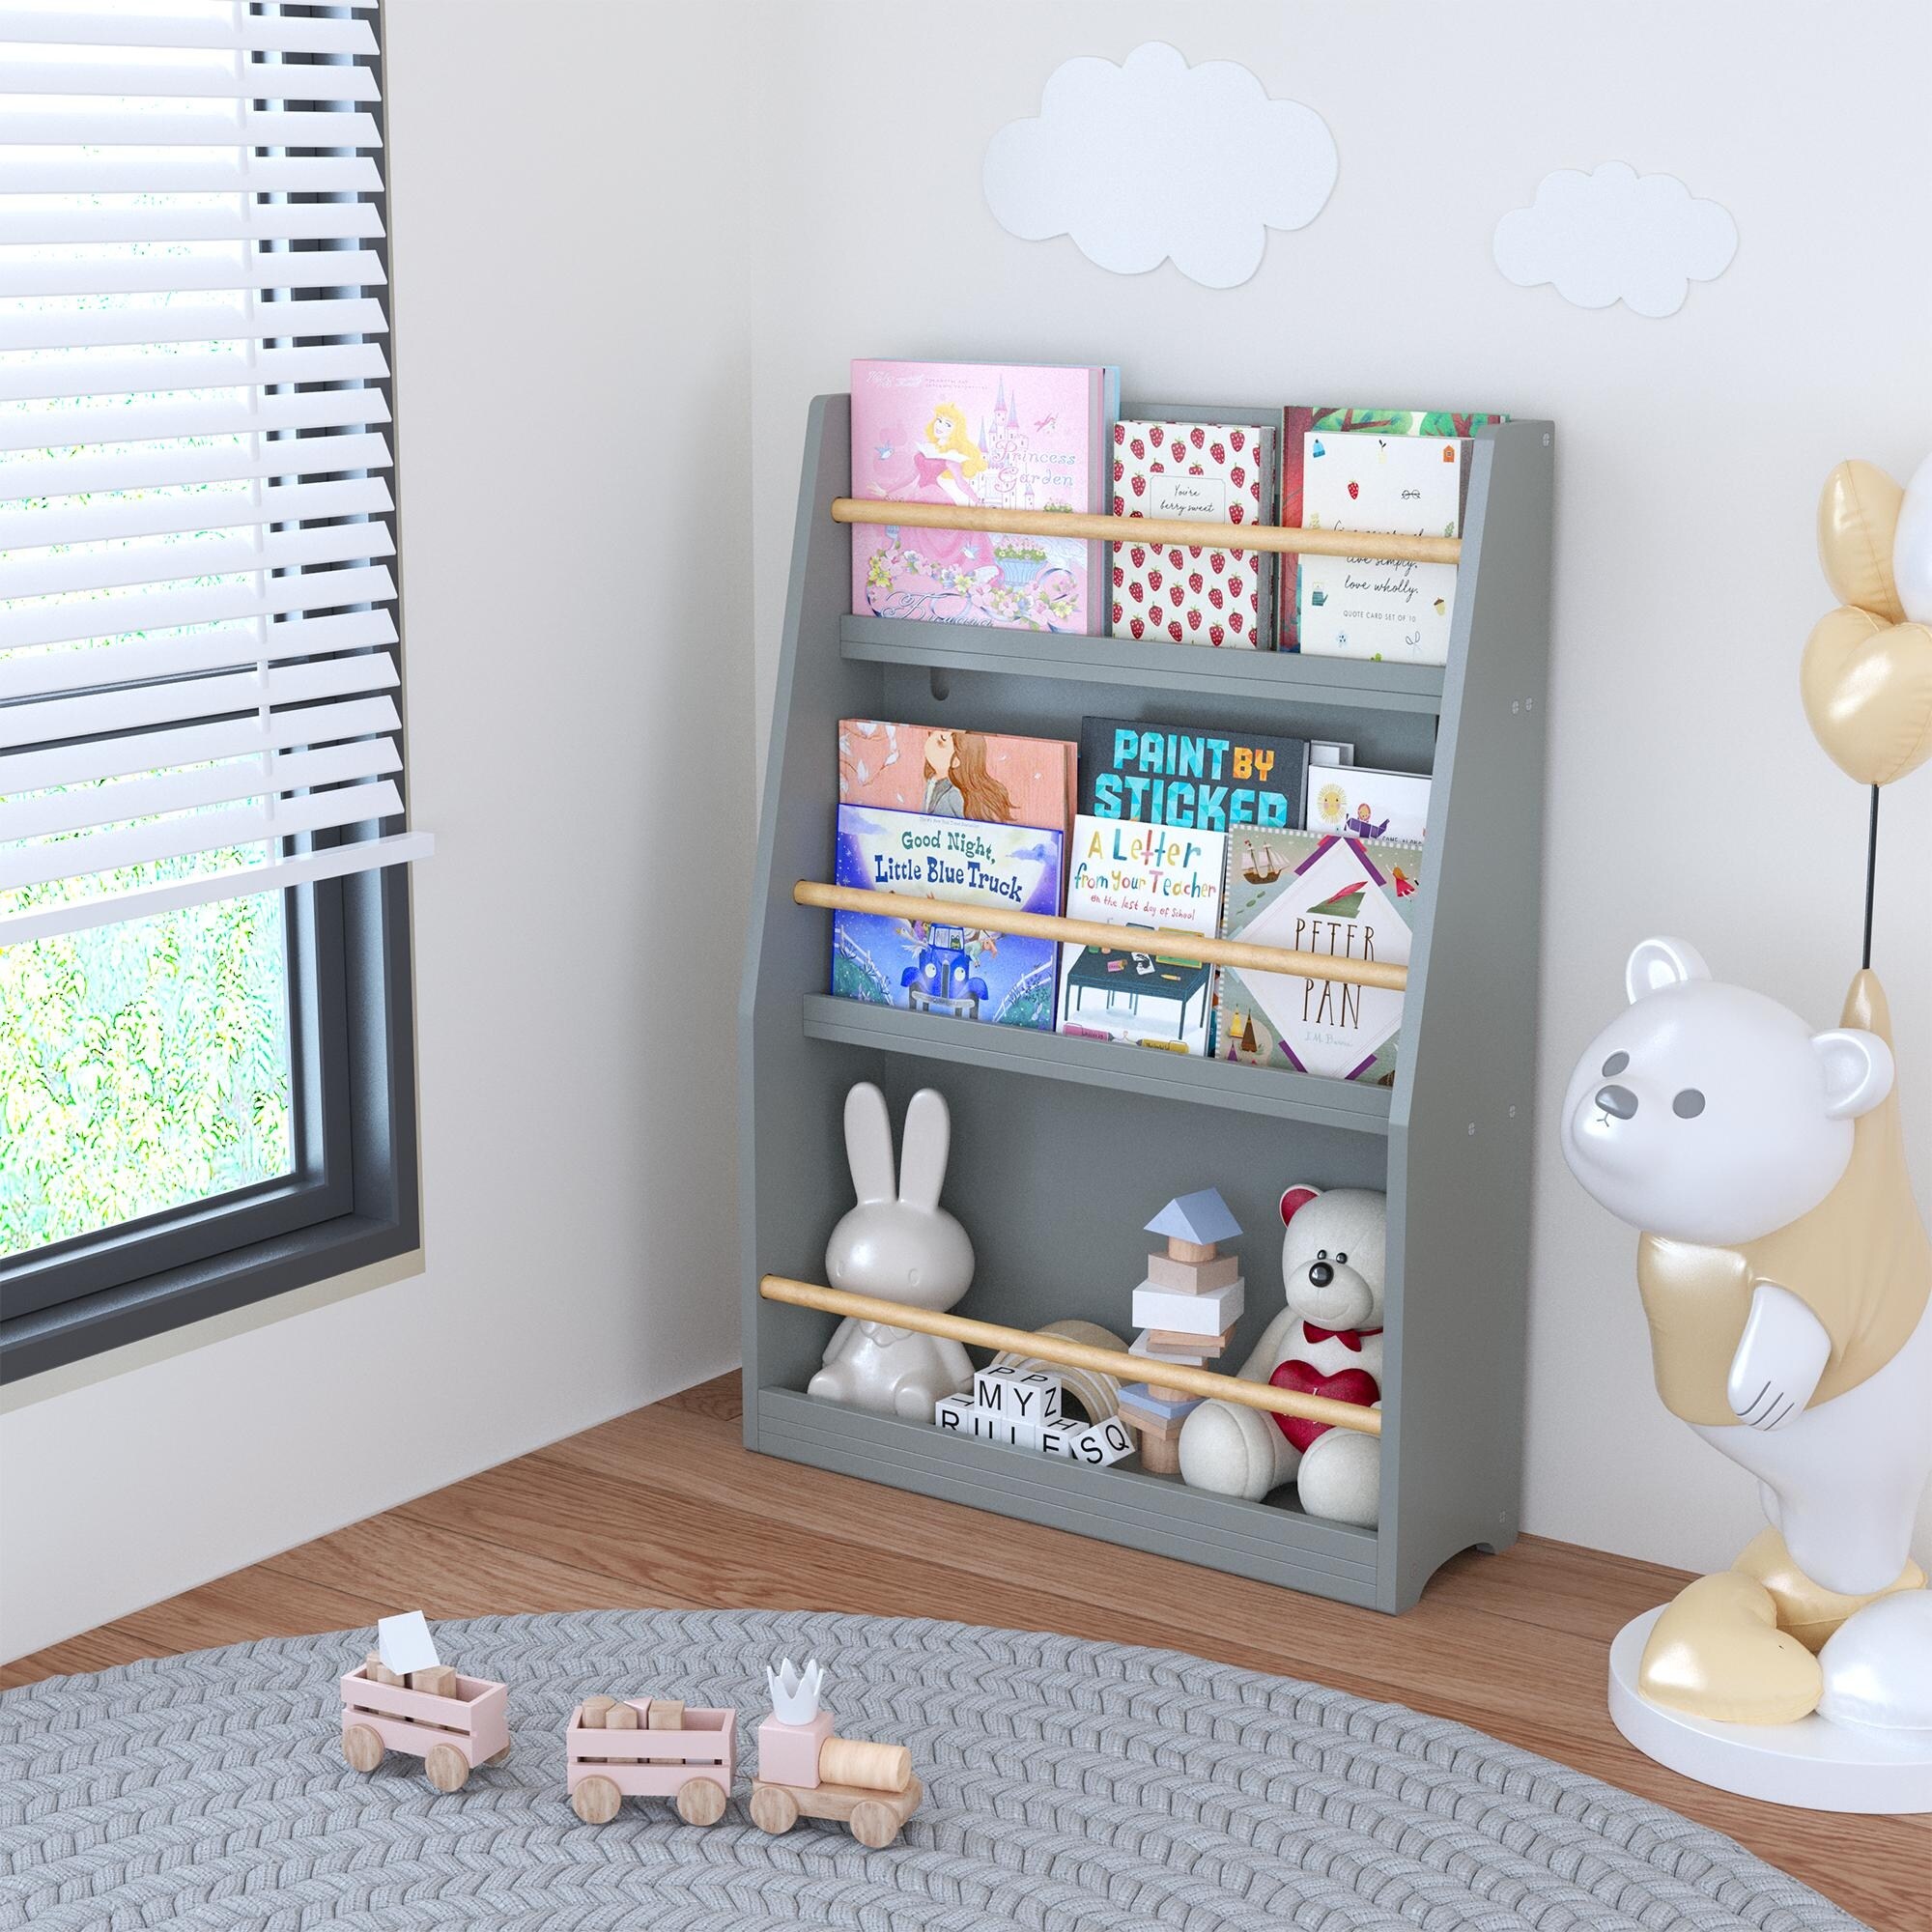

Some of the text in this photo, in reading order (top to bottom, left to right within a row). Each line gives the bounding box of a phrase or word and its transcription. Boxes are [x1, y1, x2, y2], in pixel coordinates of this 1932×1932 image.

[992, 440, 1075, 465] Princess
[994, 467, 1073, 493] Garden
[1160, 499, 1214, 516] berry sweet
[1345, 574, 1418, 603] love wholly.
[1344, 610, 1363, 618] QUOTE
[1366, 611, 1382, 621] CARD
[1113, 728, 1275, 781] PAINT BY
[1094, 773, 1289, 832] STICKER
[901, 830, 996, 865] Good Night,
[1088, 828, 1202, 867] A Letter
[874, 854, 1023, 903] Little Blue Truck
[1074, 862, 1109, 890] from
[1149, 869, 1216, 898] Teacher
[1103, 895, 1118, 907] the
[1121, 896, 1138, 911] last
[1144, 901, 1156, 917] day
[1159, 906, 1169, 916] of
[1294, 918, 1375, 962] PETER
[1302, 977, 1362, 1030] PAN
[979, 1379, 1034, 1417] MY
